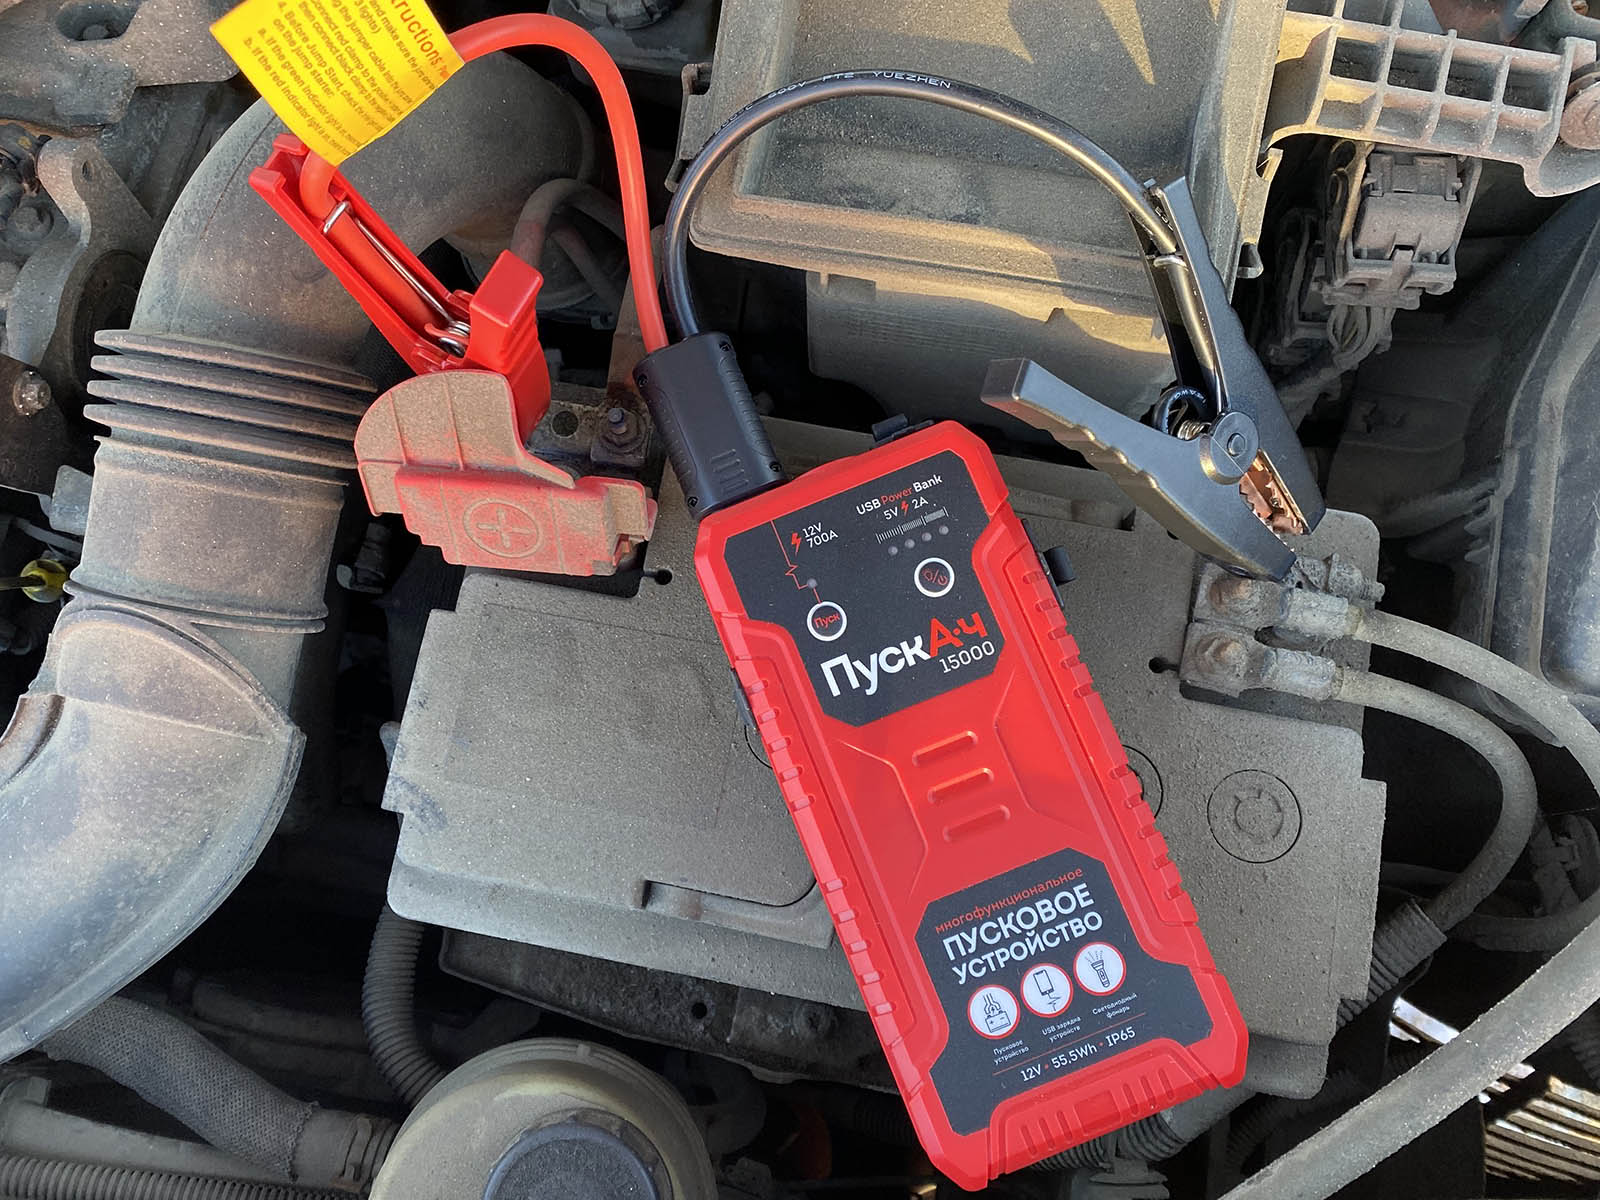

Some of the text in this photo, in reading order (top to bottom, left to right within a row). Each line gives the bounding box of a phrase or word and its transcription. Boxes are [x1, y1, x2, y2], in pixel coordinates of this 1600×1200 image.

[272, 18, 285, 32] on
[282, 30, 296, 47] the
[291, 46, 313, 69] jump
[284, 11, 309, 43] Before
[306, 44, 327, 67] Jump
[312, 21, 339, 55] connect
[336, 53, 353, 76] black
[334, 30, 349, 46] red
[345, 45, 364, 70] clamp
[339, 6, 352, 22] the
[346, 21, 372, 50] jumper
[368, 51, 386, 72] cable
[381, 17, 399, 40] make
[396, 40, 411, 58] sure
[258, 55, 272, 72] the
[269, 71, 286, 87] red
[272, 44, 286, 61] the
[281, 61, 305, 87] green
[873, 70, 952, 89] YUEZHEN
[856, 473, 943, 514] USB Power Bank
[883, 496, 928, 520] 5V 2A
[802, 522, 821, 538] 12V
[806, 530, 838, 548] 700A
[814, 612, 840, 628] Пуск
[939, 641, 994, 673] 15000
[936, 869, 1081, 932] многофункциональное
[944, 884, 1092, 959] ПУСКОВОЕ
[953, 912, 1102, 983] УСТРОЙСТВО
[1092, 992, 1137, 1014] Светодиодный
[1105, 1005, 1130, 1019] фонарь
[1041, 1016, 1081, 1035] USB зарядка
[1049, 1025, 1080, 1043] устройств
[993, 1040, 1023, 1055] Пусковое
[994, 1046, 1029, 1065] устройство
[1020, 1063, 1041, 1081] 12V
[1105, 1026, 1135, 1046] IP65
